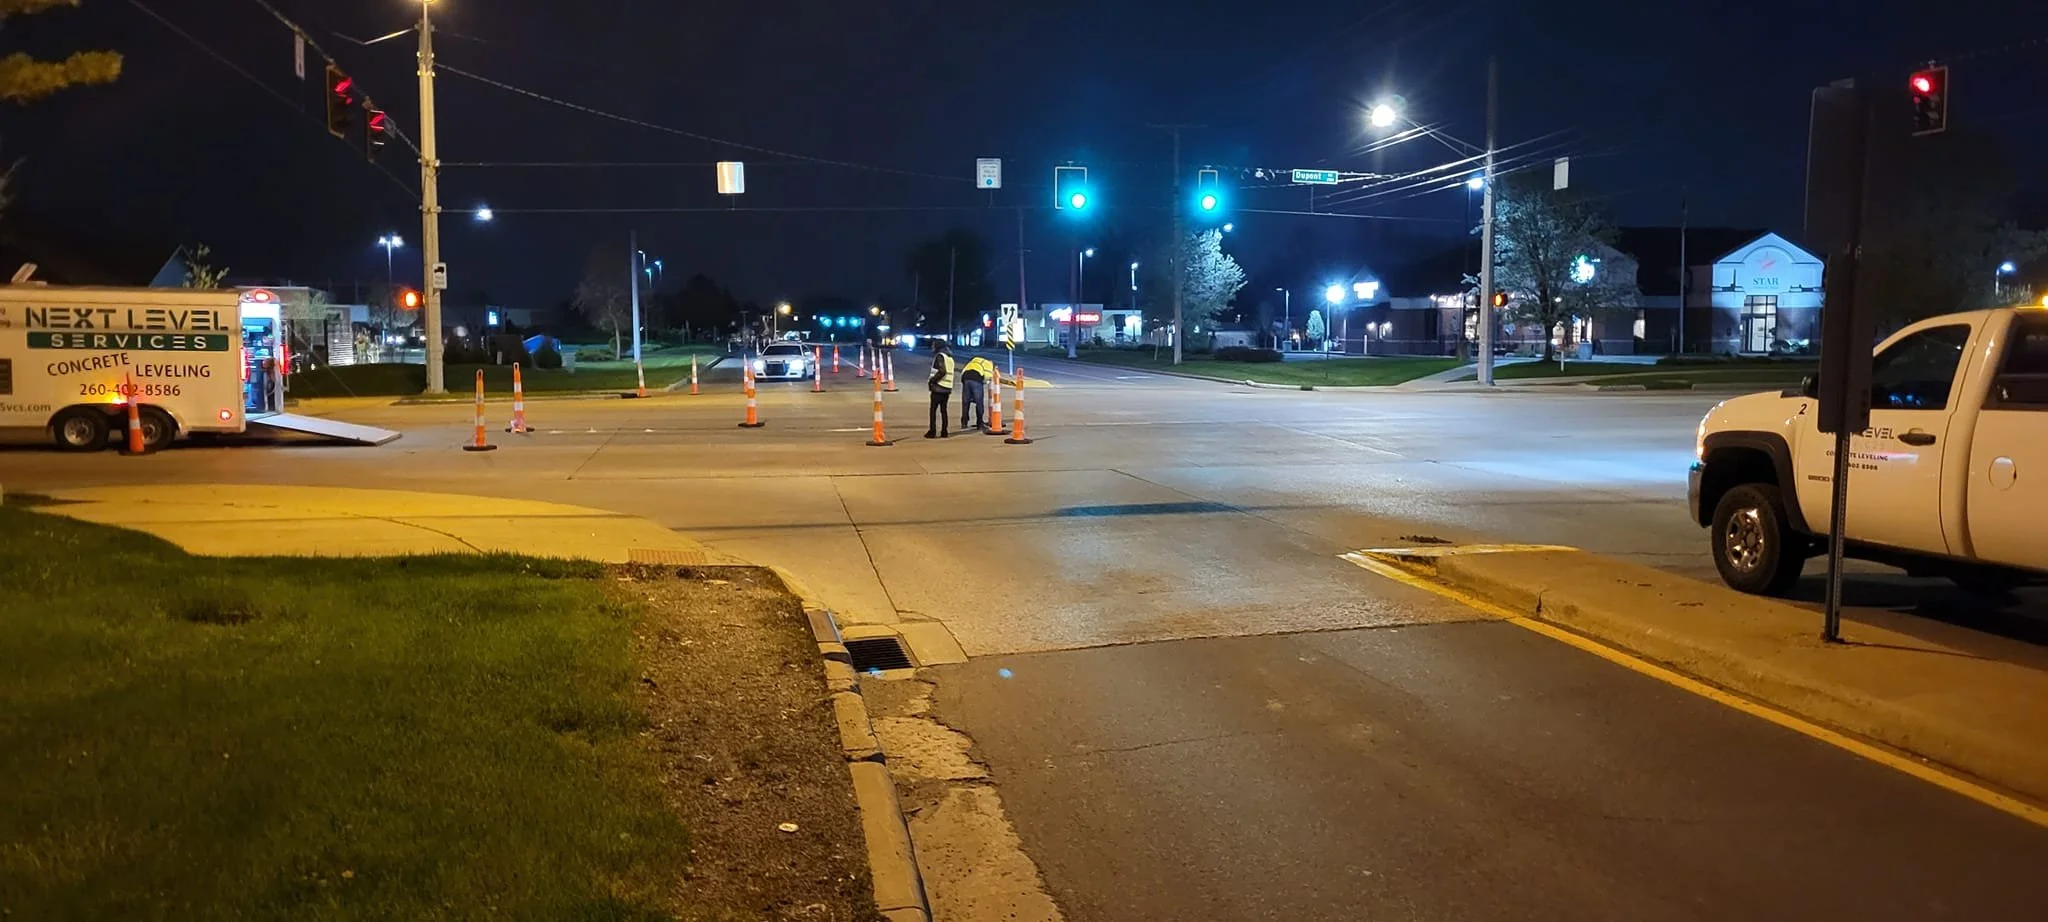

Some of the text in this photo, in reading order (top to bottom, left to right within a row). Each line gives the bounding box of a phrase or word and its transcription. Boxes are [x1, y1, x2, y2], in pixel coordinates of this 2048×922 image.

[1296, 172, 1321, 180] Dupont
[25, 307, 117, 329] NEXT
[127, 309, 229, 331] LEVEL
[51, 333, 207, 349] SERVICES
[47, 352, 211, 378] CONCRETE LEVELING
[1798, 403, 1808, 415] 2
